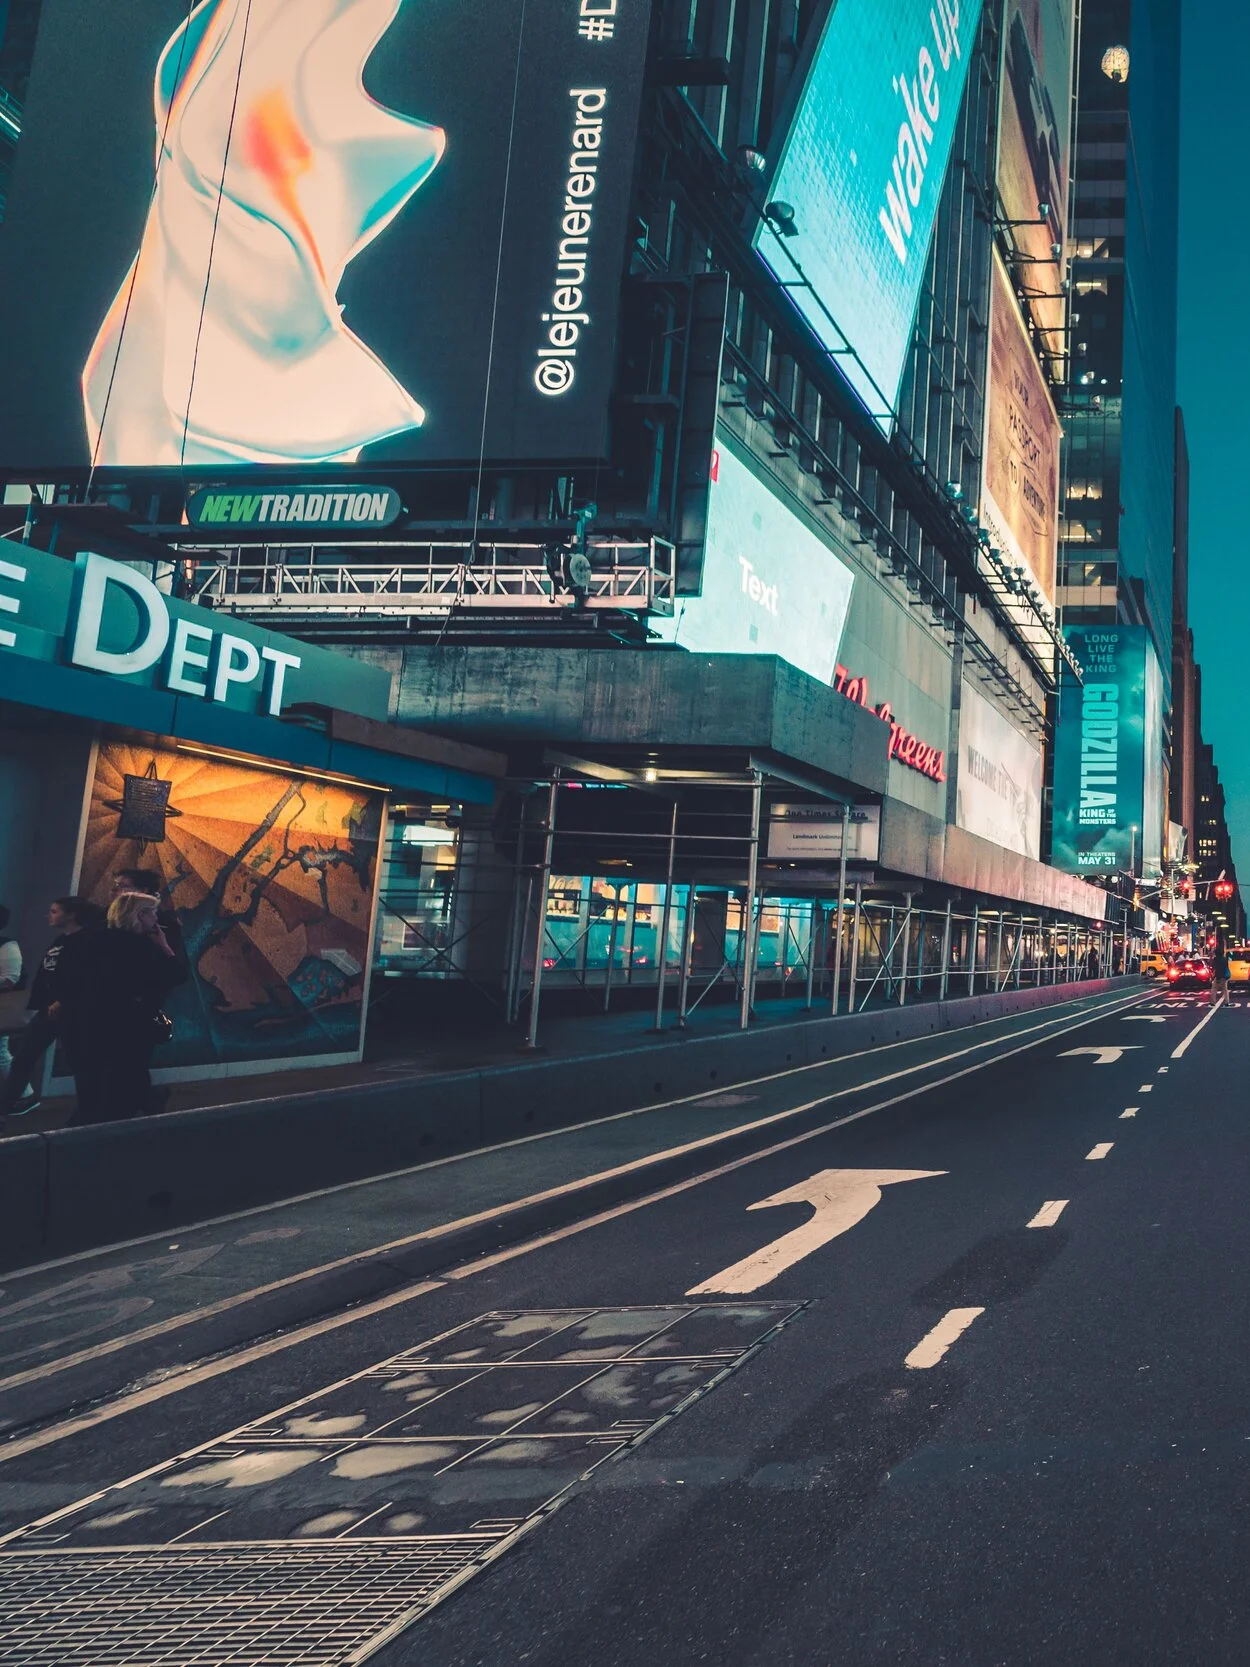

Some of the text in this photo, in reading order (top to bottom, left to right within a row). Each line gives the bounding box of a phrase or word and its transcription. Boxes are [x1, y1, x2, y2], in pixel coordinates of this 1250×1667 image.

[879, 46, 941, 266] wake
[534, 87, 607, 396] @lejeunerenard
[1008, 403, 1041, 473] PASSPORT
[738, 555, 779, 616] Text
[72, 551, 301, 716] DEPT
[1085, 634, 1118, 643] LONG
[1088, 644, 1115, 653] LIVE
[1085, 664, 1117, 673] KING
[1090, 654, 1113, 663] THE
[967, 744, 997, 793] WELCOME
[1080, 683, 1119, 808] GODZILLA
[1080, 808, 1105, 818] KING
[1078, 856, 1116, 865] MAY 31
